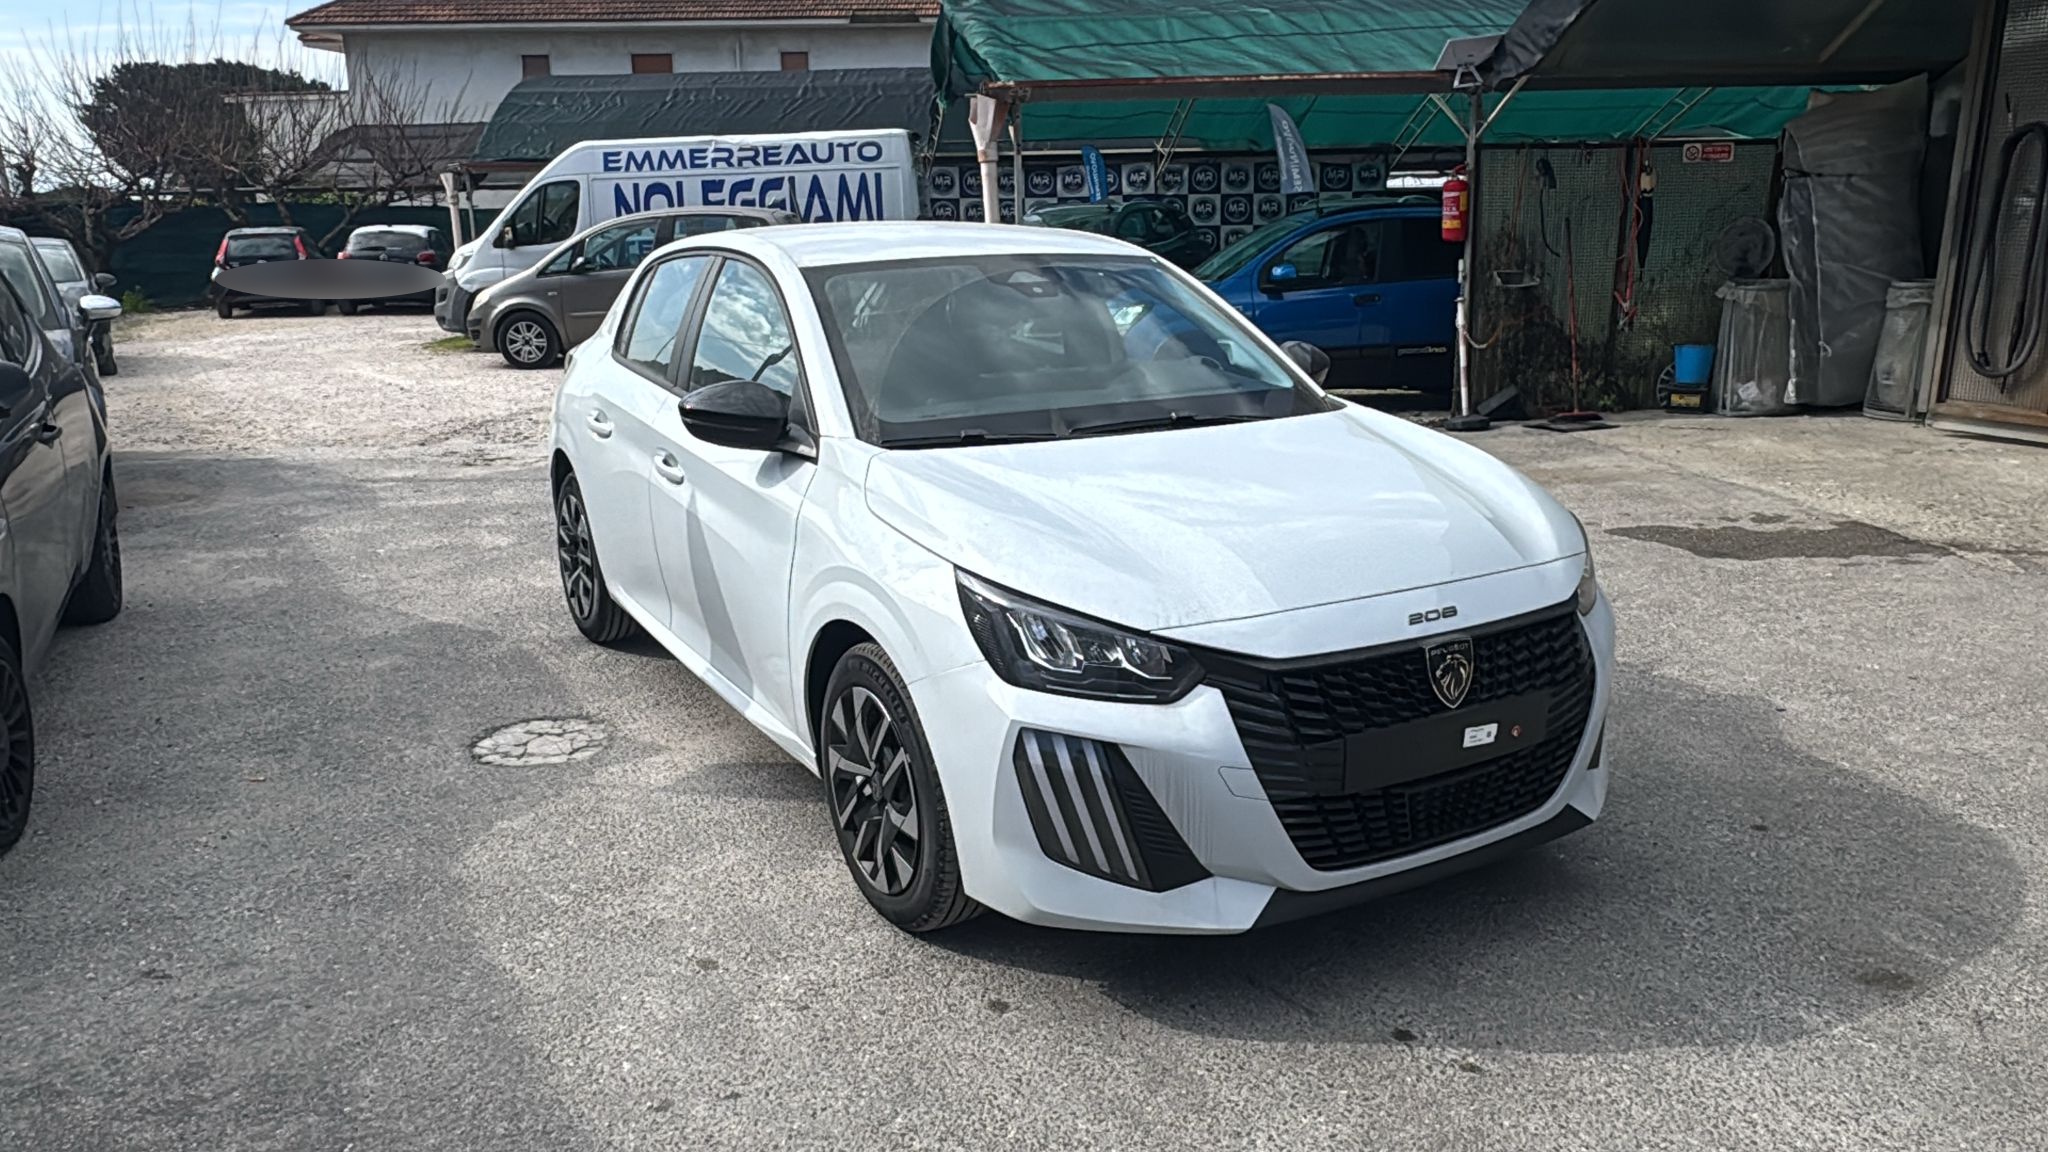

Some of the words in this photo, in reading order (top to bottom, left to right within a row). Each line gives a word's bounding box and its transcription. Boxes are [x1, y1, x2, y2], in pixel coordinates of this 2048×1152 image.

[603, 141, 883, 172] EMMERREAUTO
[935, 176, 951, 186] MR
[1033, 175, 1049, 185] MR
[1065, 174, 1081, 184] MR
[1130, 172, 1147, 181] MR
[1196, 171, 1213, 181] MR
[1229, 171, 1246, 181] MR
[936, 207, 952, 217] MR
[1196, 203, 1213, 212] MR
[1229, 203, 1246, 212] MR
[1261, 202, 1278, 212] MR
[1408, 606, 1458, 626] 208
